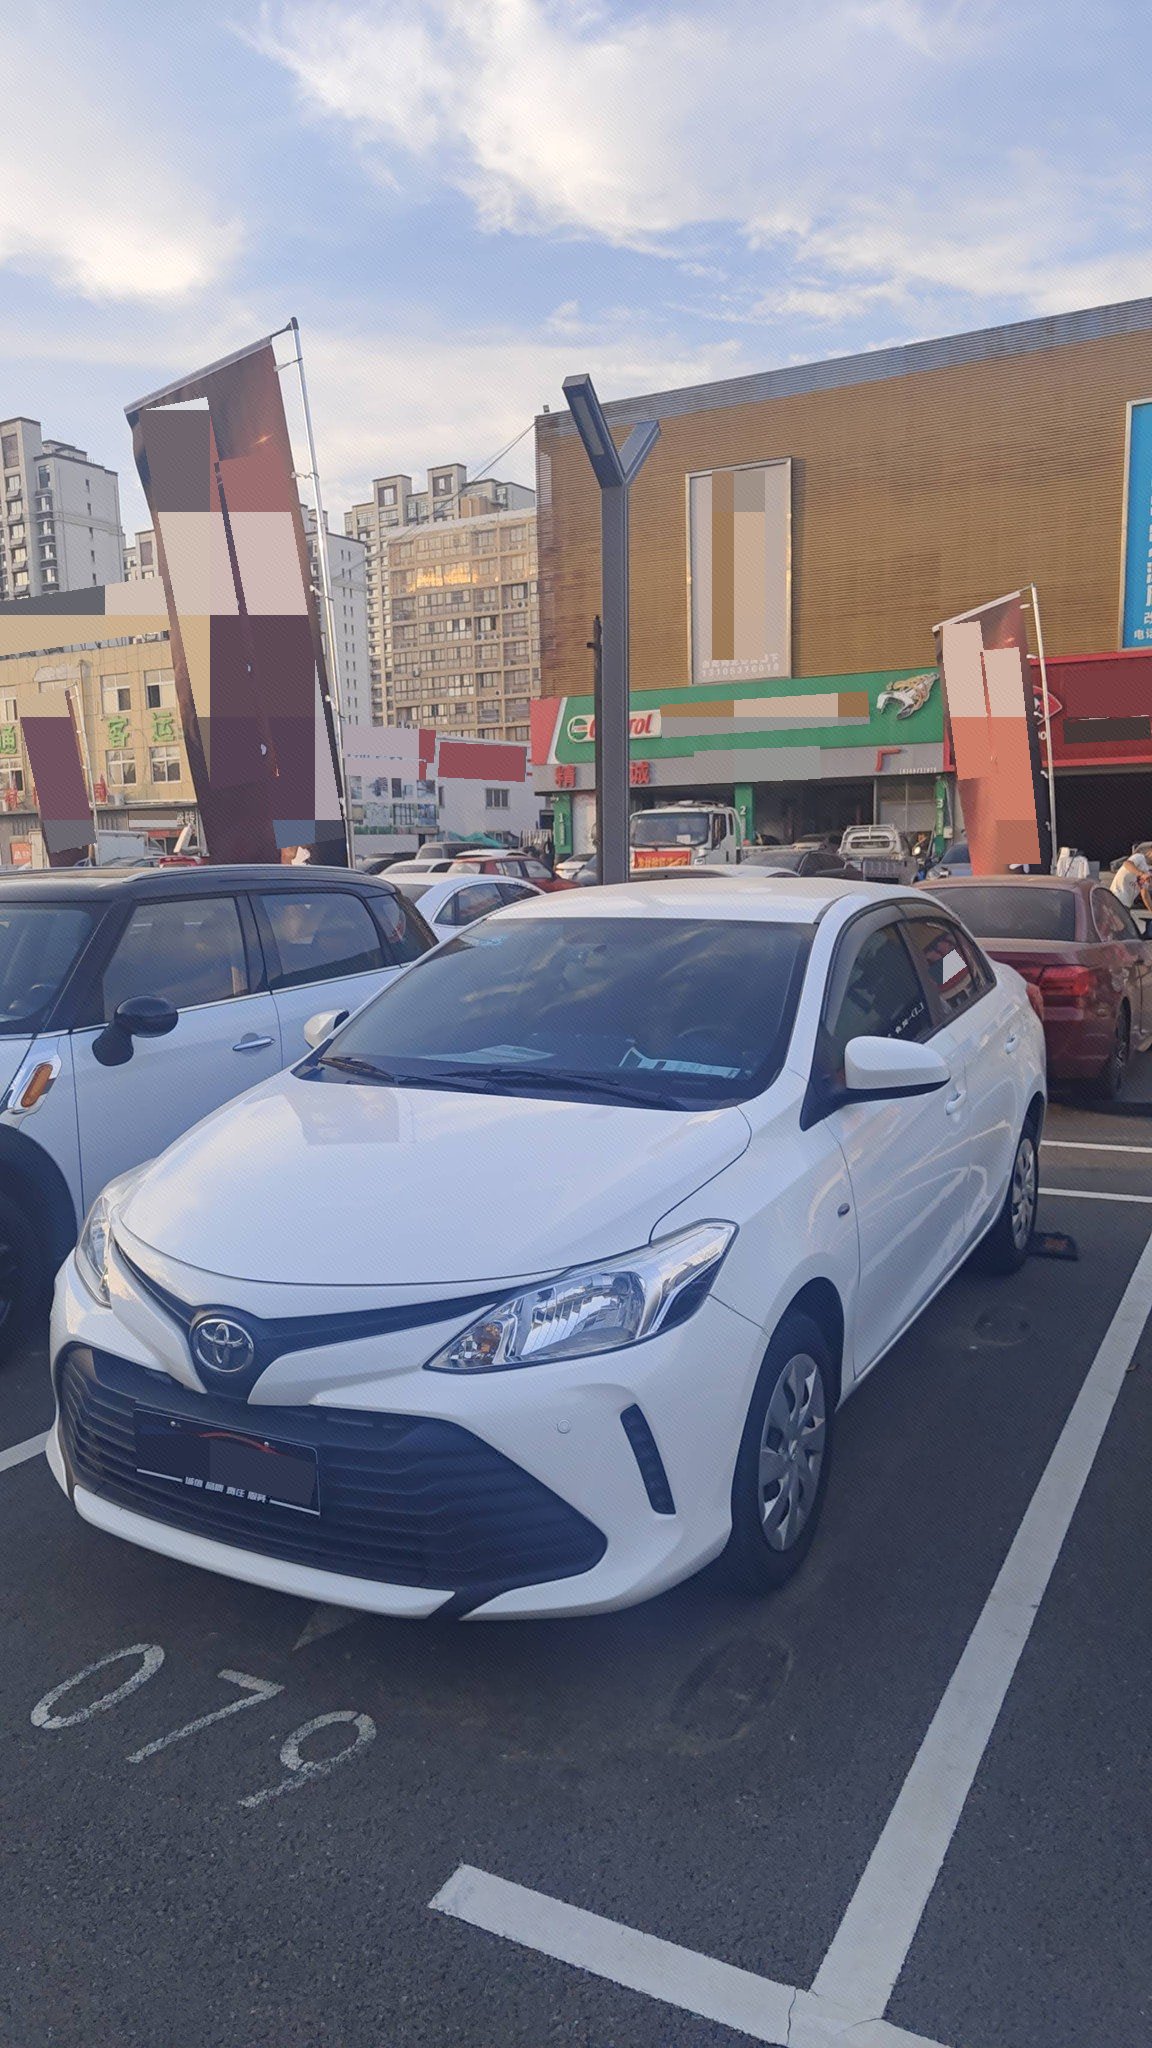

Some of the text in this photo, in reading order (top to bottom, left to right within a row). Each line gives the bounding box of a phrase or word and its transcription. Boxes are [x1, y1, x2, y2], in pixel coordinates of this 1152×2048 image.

[875, 748, 902, 772] 厂
[936, 798, 944, 809] 3
[739, 805, 747, 816] 2
[558, 812, 564, 822] 1
[30, 1643, 377, 1808] 079
